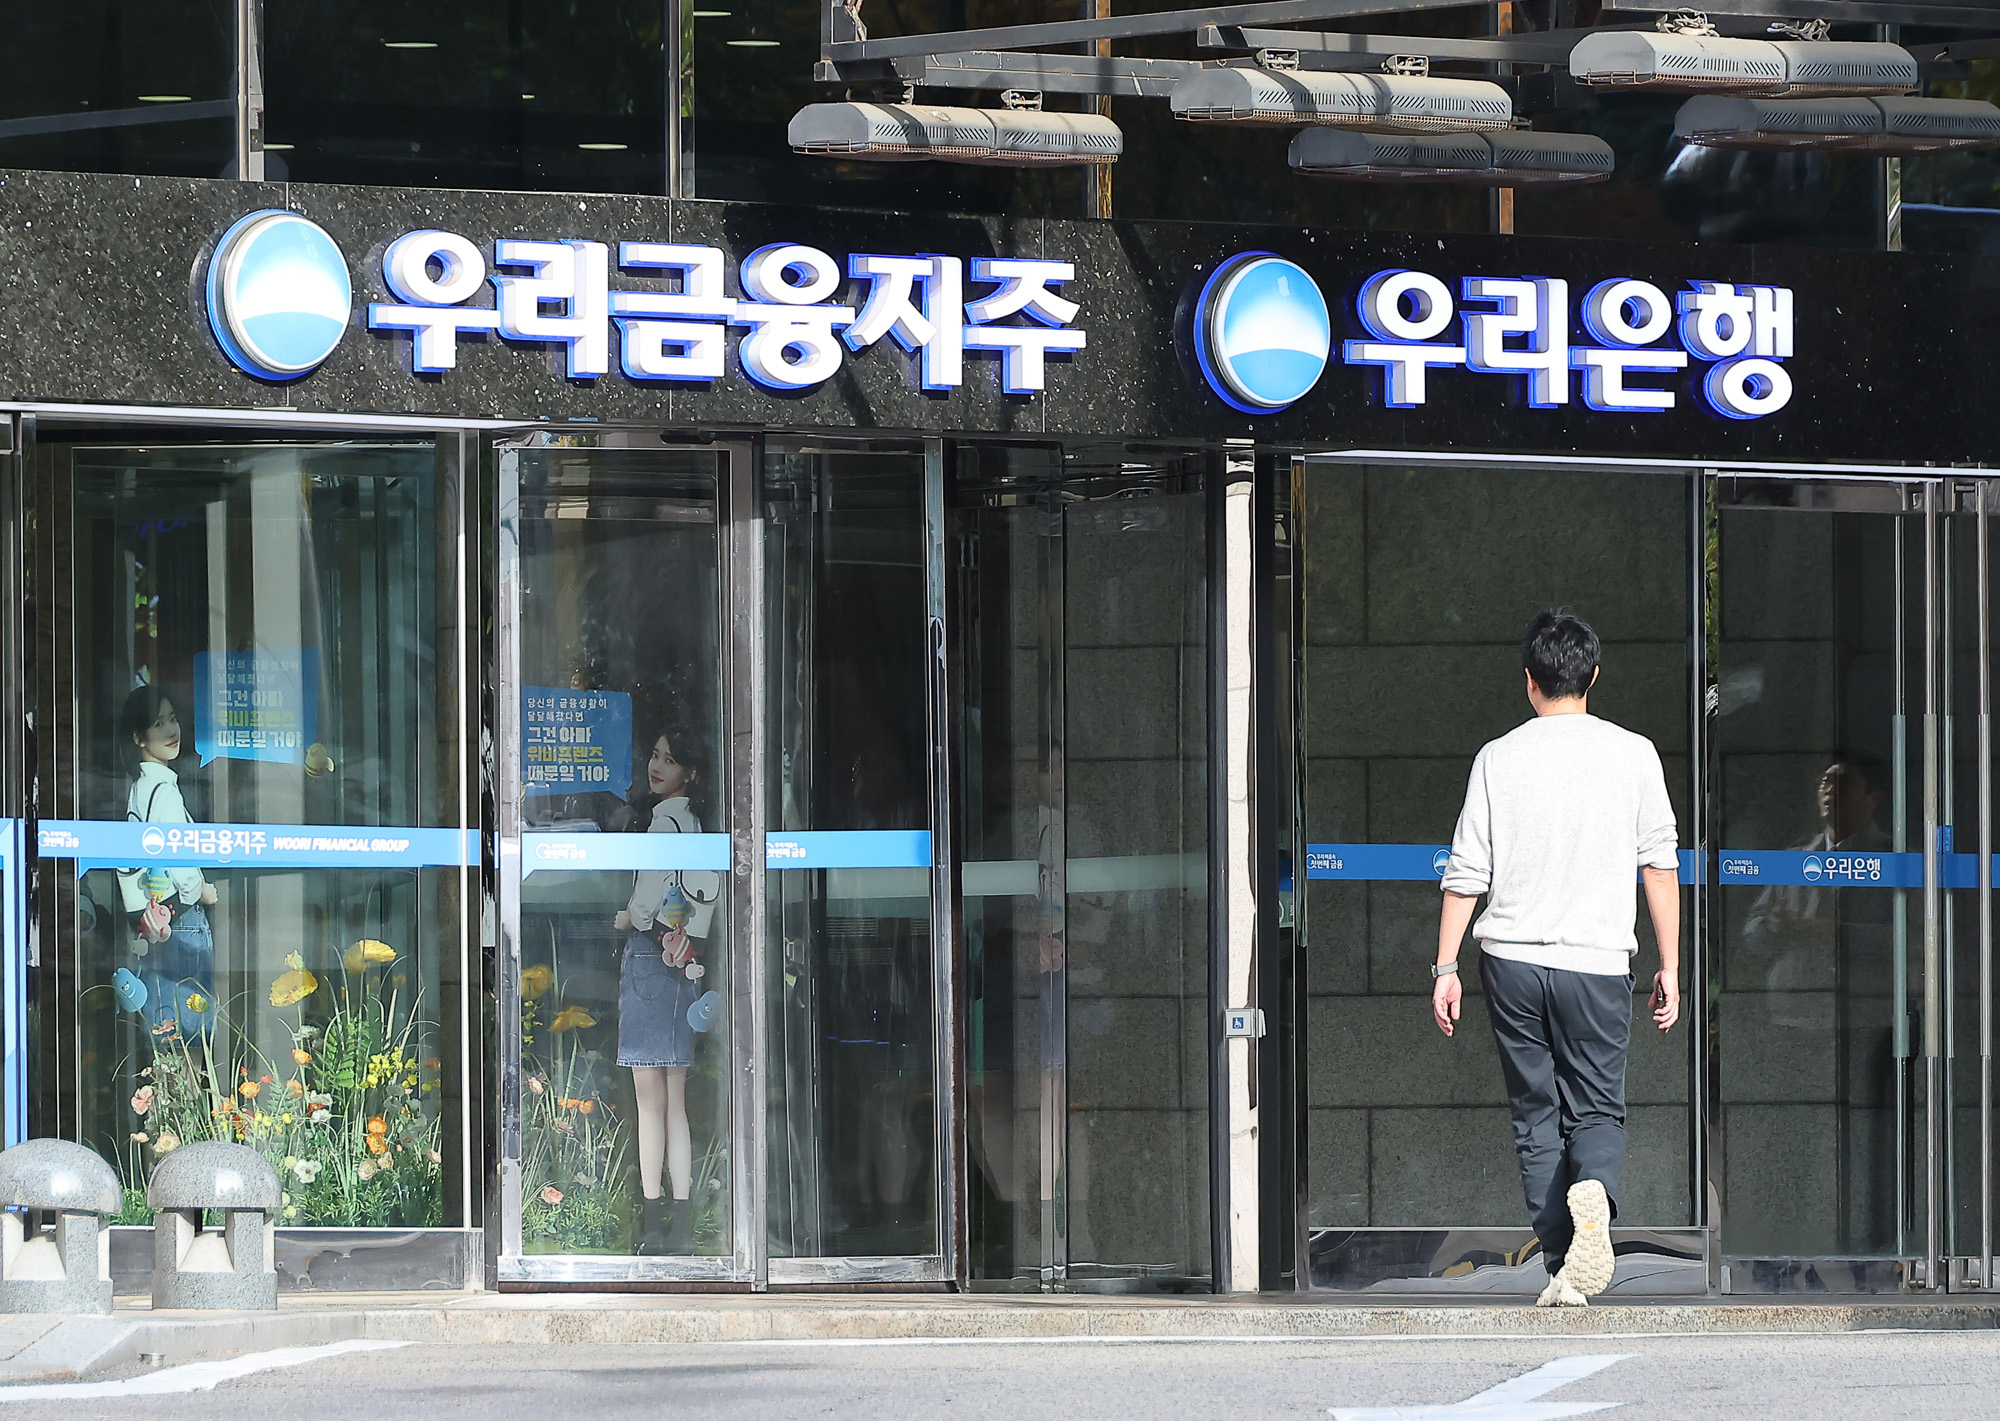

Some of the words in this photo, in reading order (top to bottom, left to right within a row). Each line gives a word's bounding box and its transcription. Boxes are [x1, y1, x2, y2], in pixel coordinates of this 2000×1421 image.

[369, 228, 1087, 394] 우리금융지주
[1344, 267, 1795, 420] 우리은행
[218, 690, 248, 707] 그건
[251, 690, 283, 707] 아마
[527, 698, 554, 709] 당신의
[559, 698, 607, 709] 금융생활이
[217, 710, 296, 728] 위비프렌즈
[217, 730, 267, 748] 때문일
[269, 731, 302, 748] 거야
[527, 726, 557, 743] 그건
[559, 726, 592, 743] 아마
[527, 745, 604, 763] 위비프렌즈
[527, 765, 575, 782] 때문일
[576, 765, 610, 782] 거야
[166, 829, 267, 855] 우리금융지주
[273, 837, 312, 850] WOORI
[312, 838, 370, 851] FINANCIAL
[370, 839, 410, 852] GROUP
[1330, 860, 1343, 870] 금융
[1747, 865, 1760, 875] 금융
[1823, 857, 1881, 880] 우리은행
